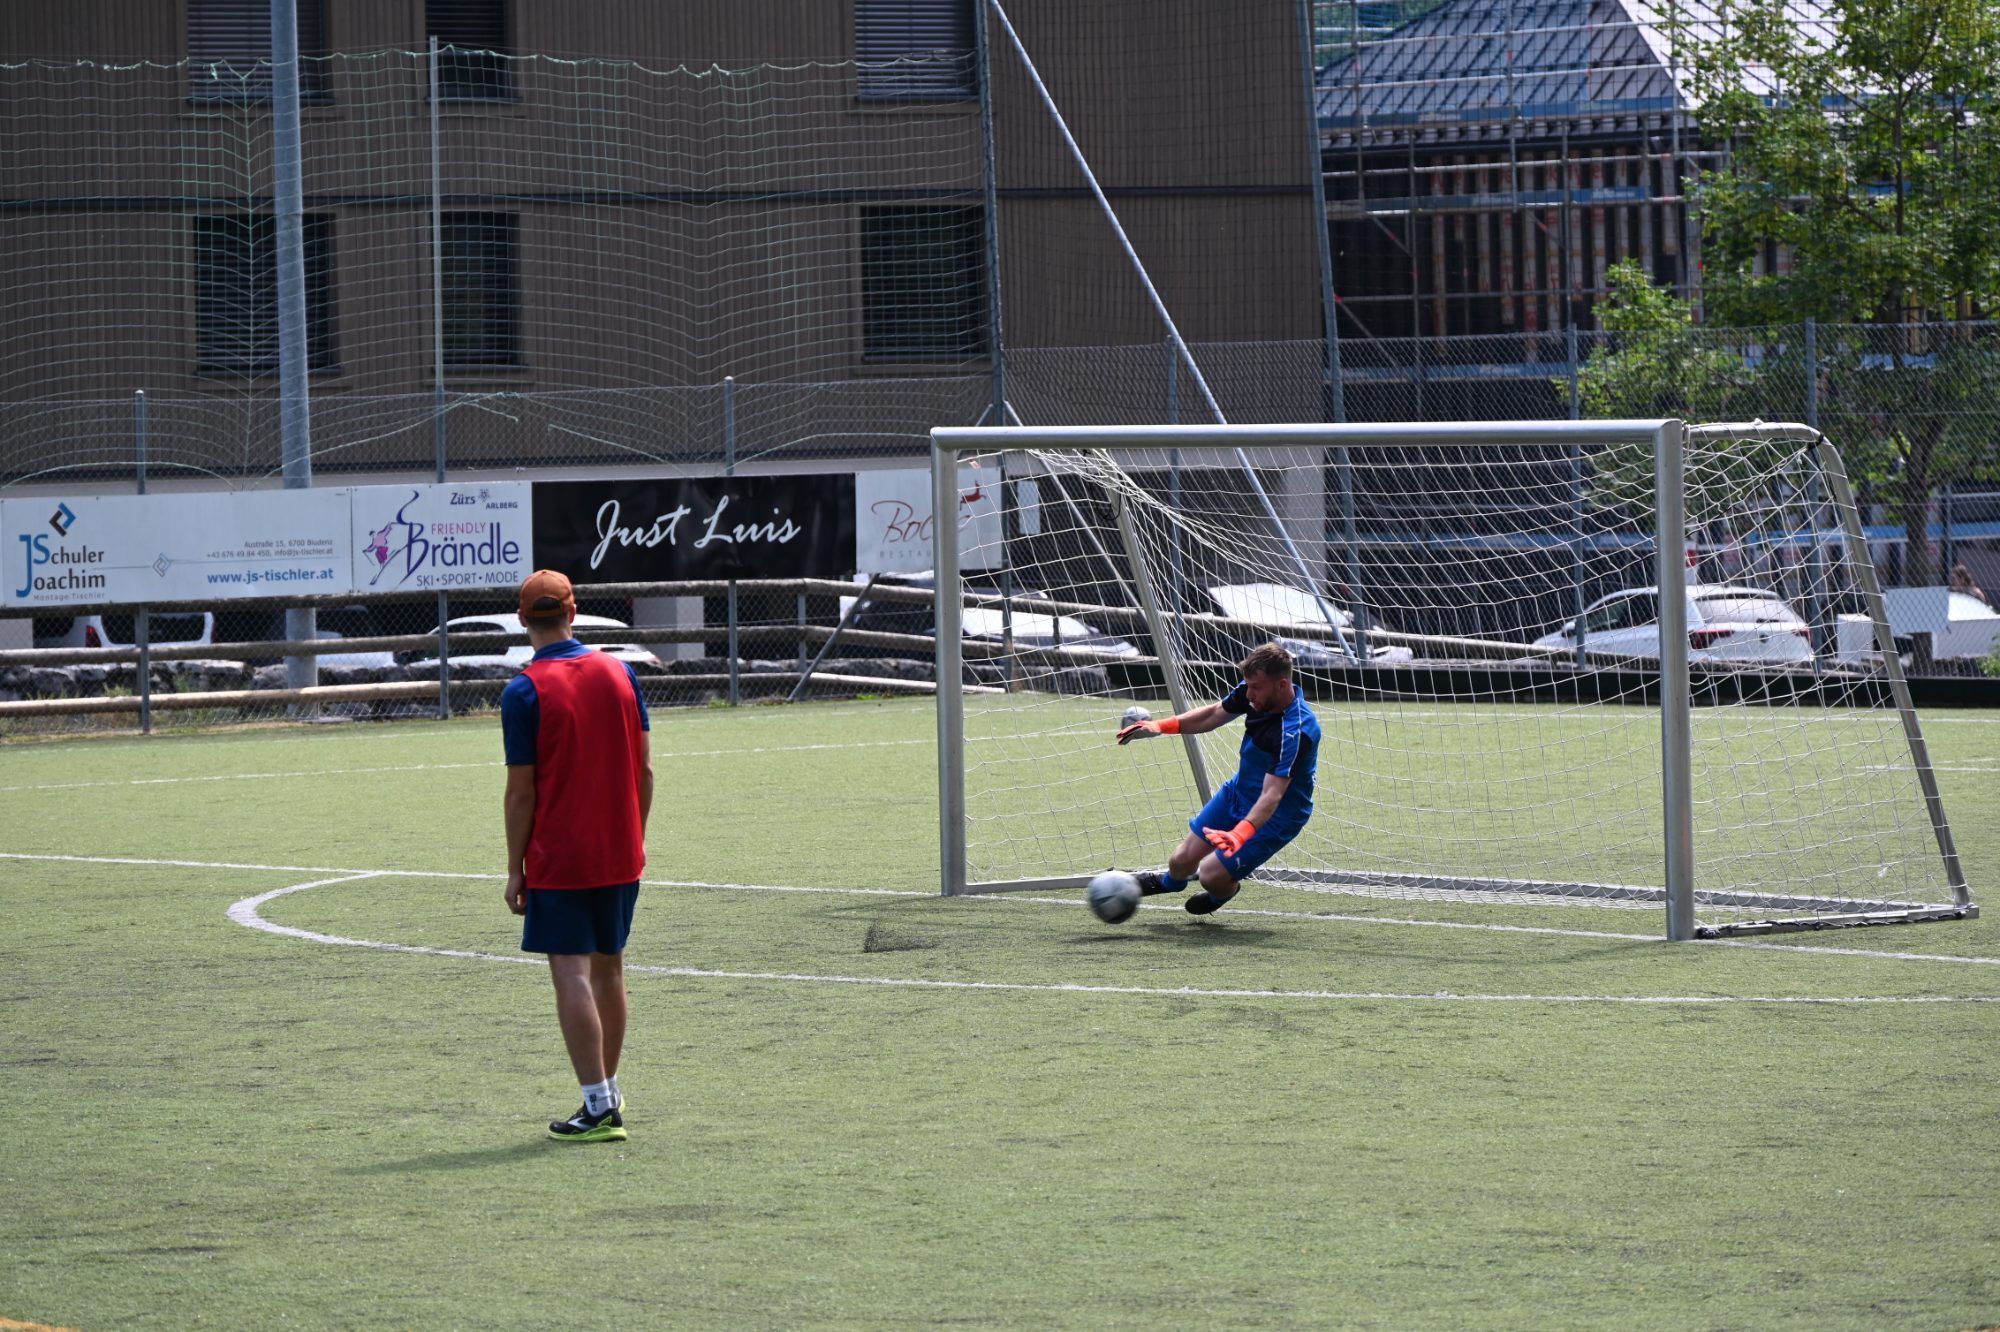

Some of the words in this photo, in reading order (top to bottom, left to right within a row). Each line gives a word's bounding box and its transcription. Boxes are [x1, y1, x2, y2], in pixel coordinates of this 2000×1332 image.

[450, 492, 476, 505] Zürs
[485, 502, 518, 510] ARLBERG
[431, 522, 486, 535] FRIENDLY
[590, 499, 691, 570] Just
[694, 495, 801, 549] Luis
[407, 522, 519, 575] Brändle
[207, 568, 334, 584] www.js-tischler.at
[416, 575, 434, 587] SKI
[441, 572, 476, 586] SPORT
[484, 571, 519, 584] MODE
